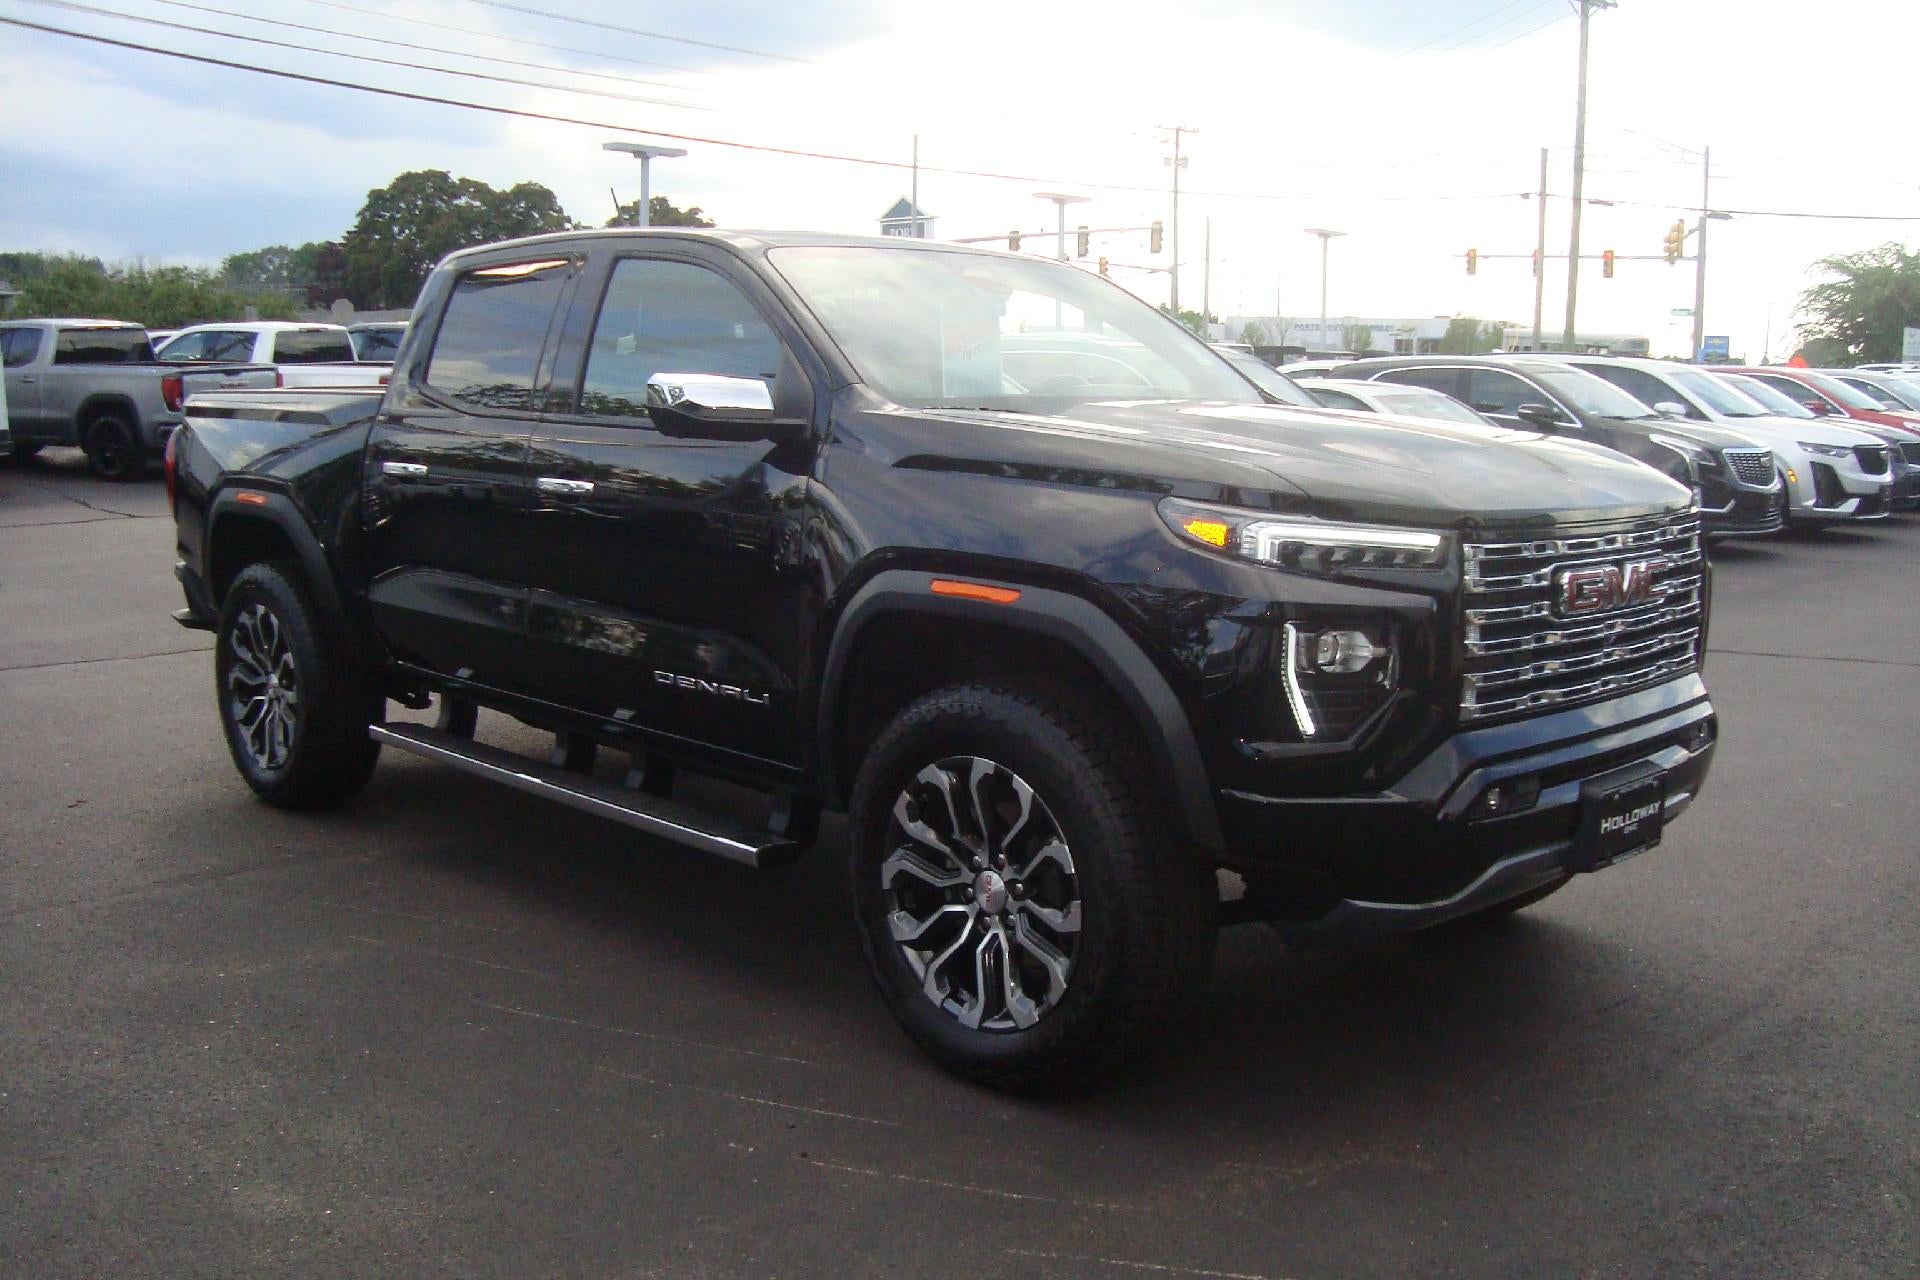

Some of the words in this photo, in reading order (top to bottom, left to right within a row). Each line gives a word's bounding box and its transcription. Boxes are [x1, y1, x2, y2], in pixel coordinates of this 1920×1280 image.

[1559, 557, 1670, 614] GMC
[653, 670, 770, 705] DENALI
[1600, 801, 1661, 834] HOLLOWAY
